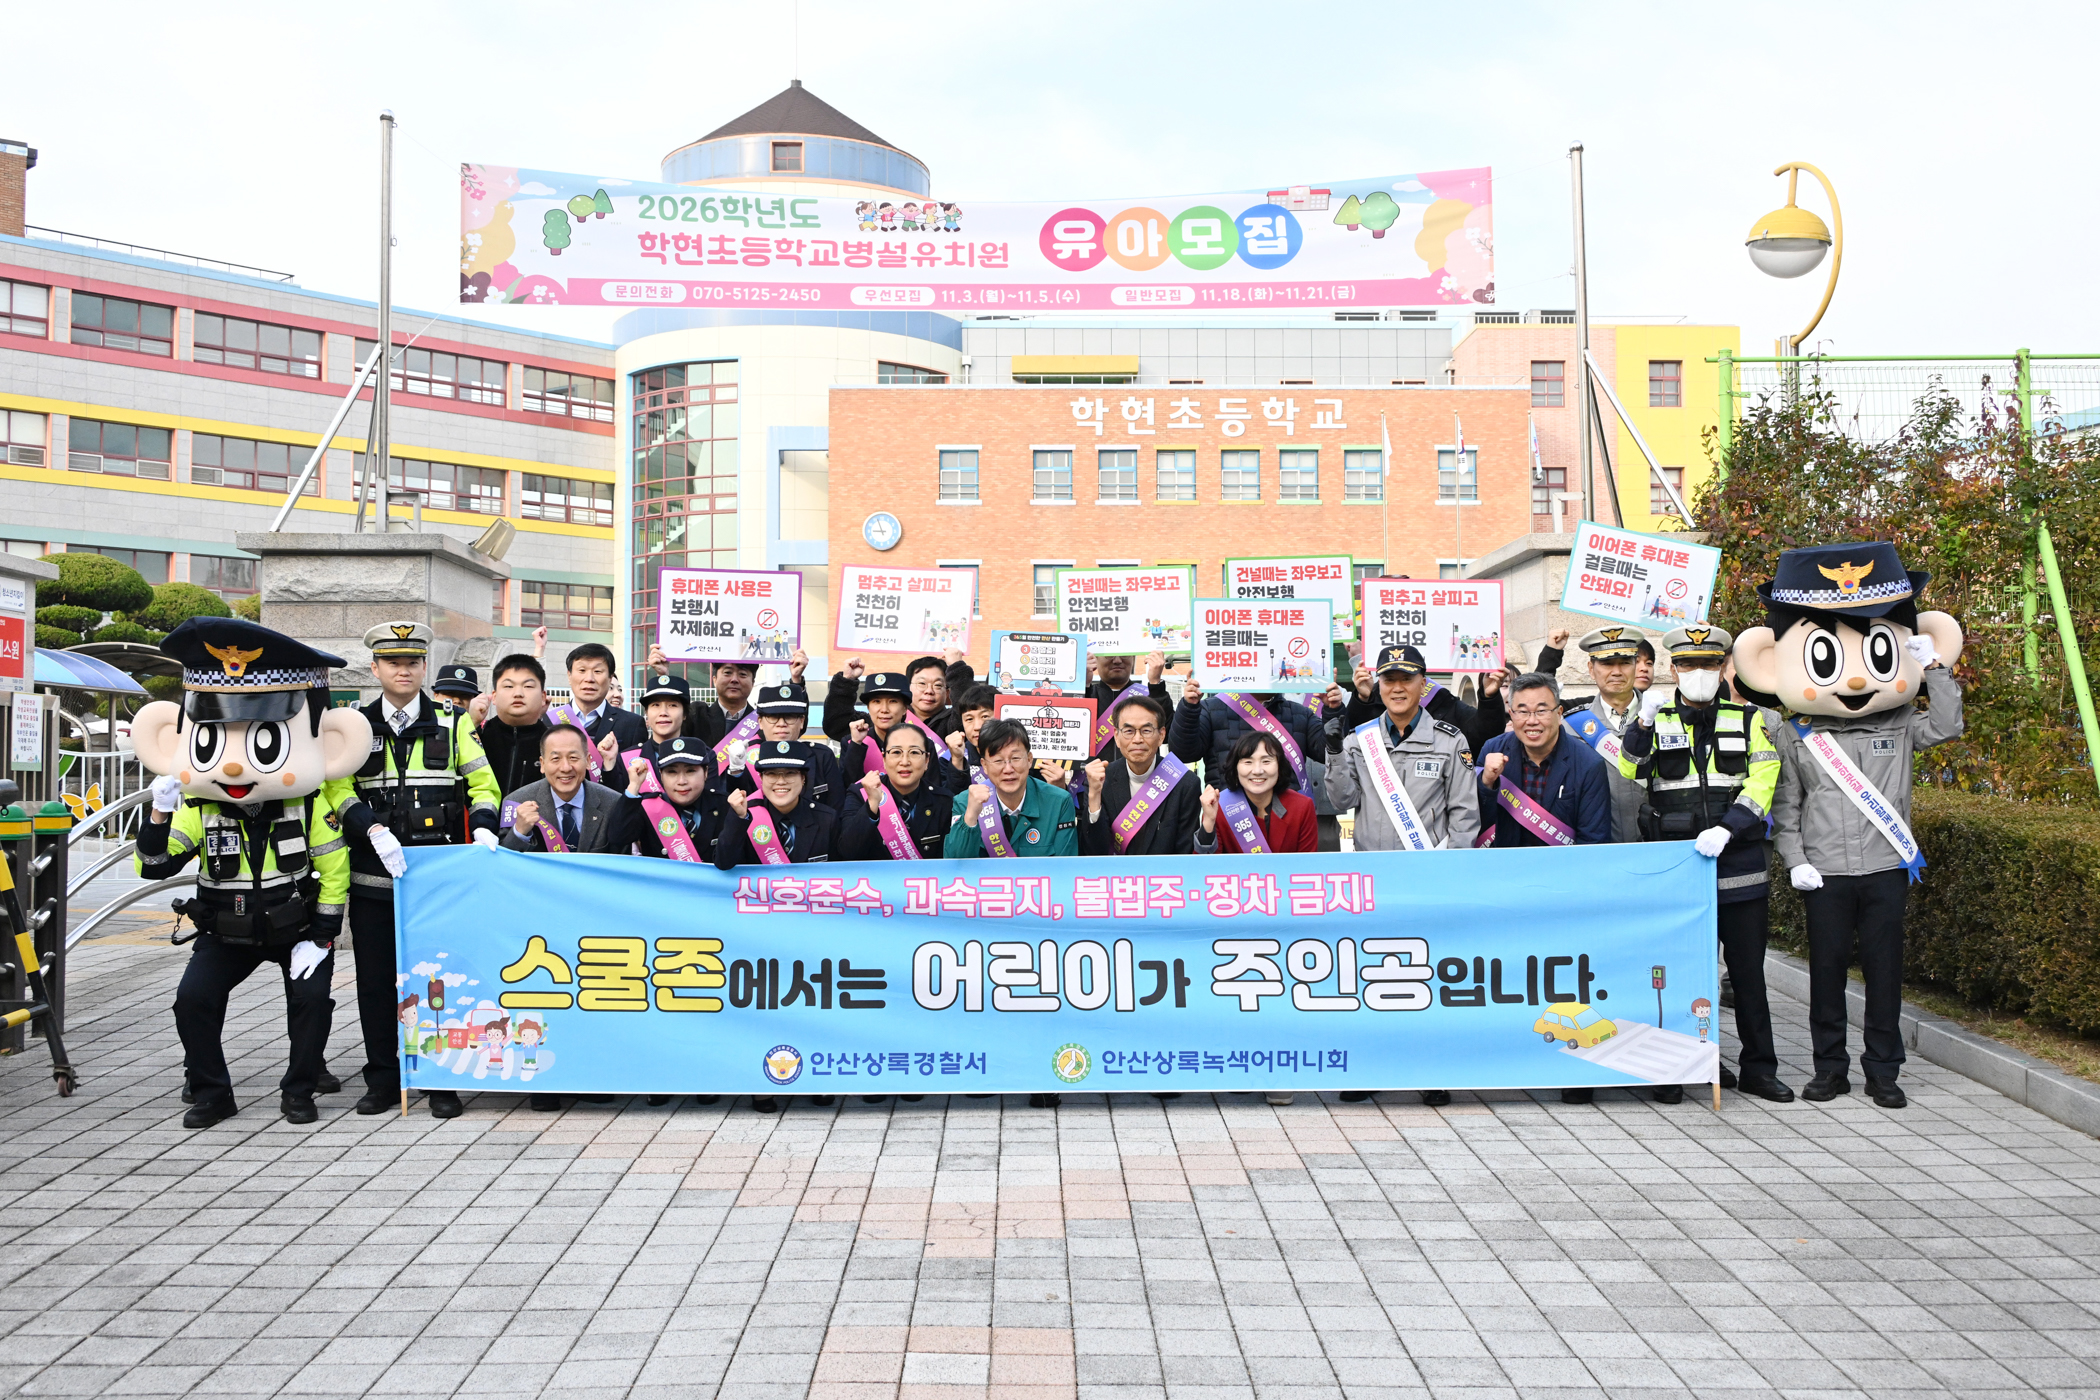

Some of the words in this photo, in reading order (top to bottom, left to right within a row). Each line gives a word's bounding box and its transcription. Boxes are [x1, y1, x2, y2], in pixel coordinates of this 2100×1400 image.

[638, 195, 821, 230] 2026학년도
[1053, 215, 1288, 260] 유아모집
[638, 231, 1008, 269] 학현초등학교병설유치원
[615, 284, 673, 300] 문의전화
[693, 286, 821, 302] 070-5125-2450
[864, 288, 921, 303] 우선모집
[941, 288, 1080, 305] 11.3.(월)~11.5.(수)
[1125, 288, 1182, 303] 일반모집
[1201, 285, 1356, 303] 11.18.(화)~11.21.(금)
[1070, 396, 1347, 437] 학현초등학교
[1588, 533, 1637, 557] 이어폰
[1640, 543, 1690, 570] 휴대폰
[1237, 566, 1287, 582] 건널때는
[1291, 564, 1342, 580] 좌우보고
[1585, 552, 1649, 582] 걸을때는
[671, 578, 719, 595] 휴대폰
[724, 580, 772, 597] 사용은
[858, 575, 902, 592] 멈추고
[907, 577, 952, 593] 살피고
[1068, 578, 1122, 593] 건널때는
[1126, 576, 1180, 592] 좌우보고
[1237, 585, 1295, 599] 안전보행
[1580, 573, 1633, 599] 안돼요!
[671, 598, 719, 616] 보행시
[855, 593, 900, 610] 천천히
[1068, 596, 1129, 612] 안전보행
[1379, 590, 1427, 606] 멈추고
[1431, 590, 1478, 606] 살피고
[1603, 601, 1626, 613] 안산시
[854, 613, 899, 630] 건너요
[1068, 616, 1120, 632] 하세요!
[1205, 609, 1252, 625] 이어폰
[1257, 609, 1304, 625] 휴대폰
[1379, 609, 1427, 626] 천천히
[670, 620, 734, 638] 자제해요
[1205, 630, 1268, 646] 걸을때는
[1379, 630, 1427, 646] 건너요
[1205, 651, 1258, 668] 안돼요!
[1662, 736, 1686, 744] 경찰
[1874, 740, 1894, 749] 경찰
[1418, 762, 1438, 771] 경찰
[734, 876, 891, 918] 신호준수,
[903, 876, 1064, 919] 과속금지,
[1073, 875, 1282, 918] 불법주·정차
[1289, 873, 1375, 915] 금지!
[500, 934, 888, 1013] 스쿨존에서는
[912, 938, 1191, 1013] 어린이가
[1211, 937, 1609, 1012] 주인공입니다.
[810, 1051, 987, 1076] 안산상록경찰서
[1102, 1048, 1348, 1074] 안산상록녹색어머니회
